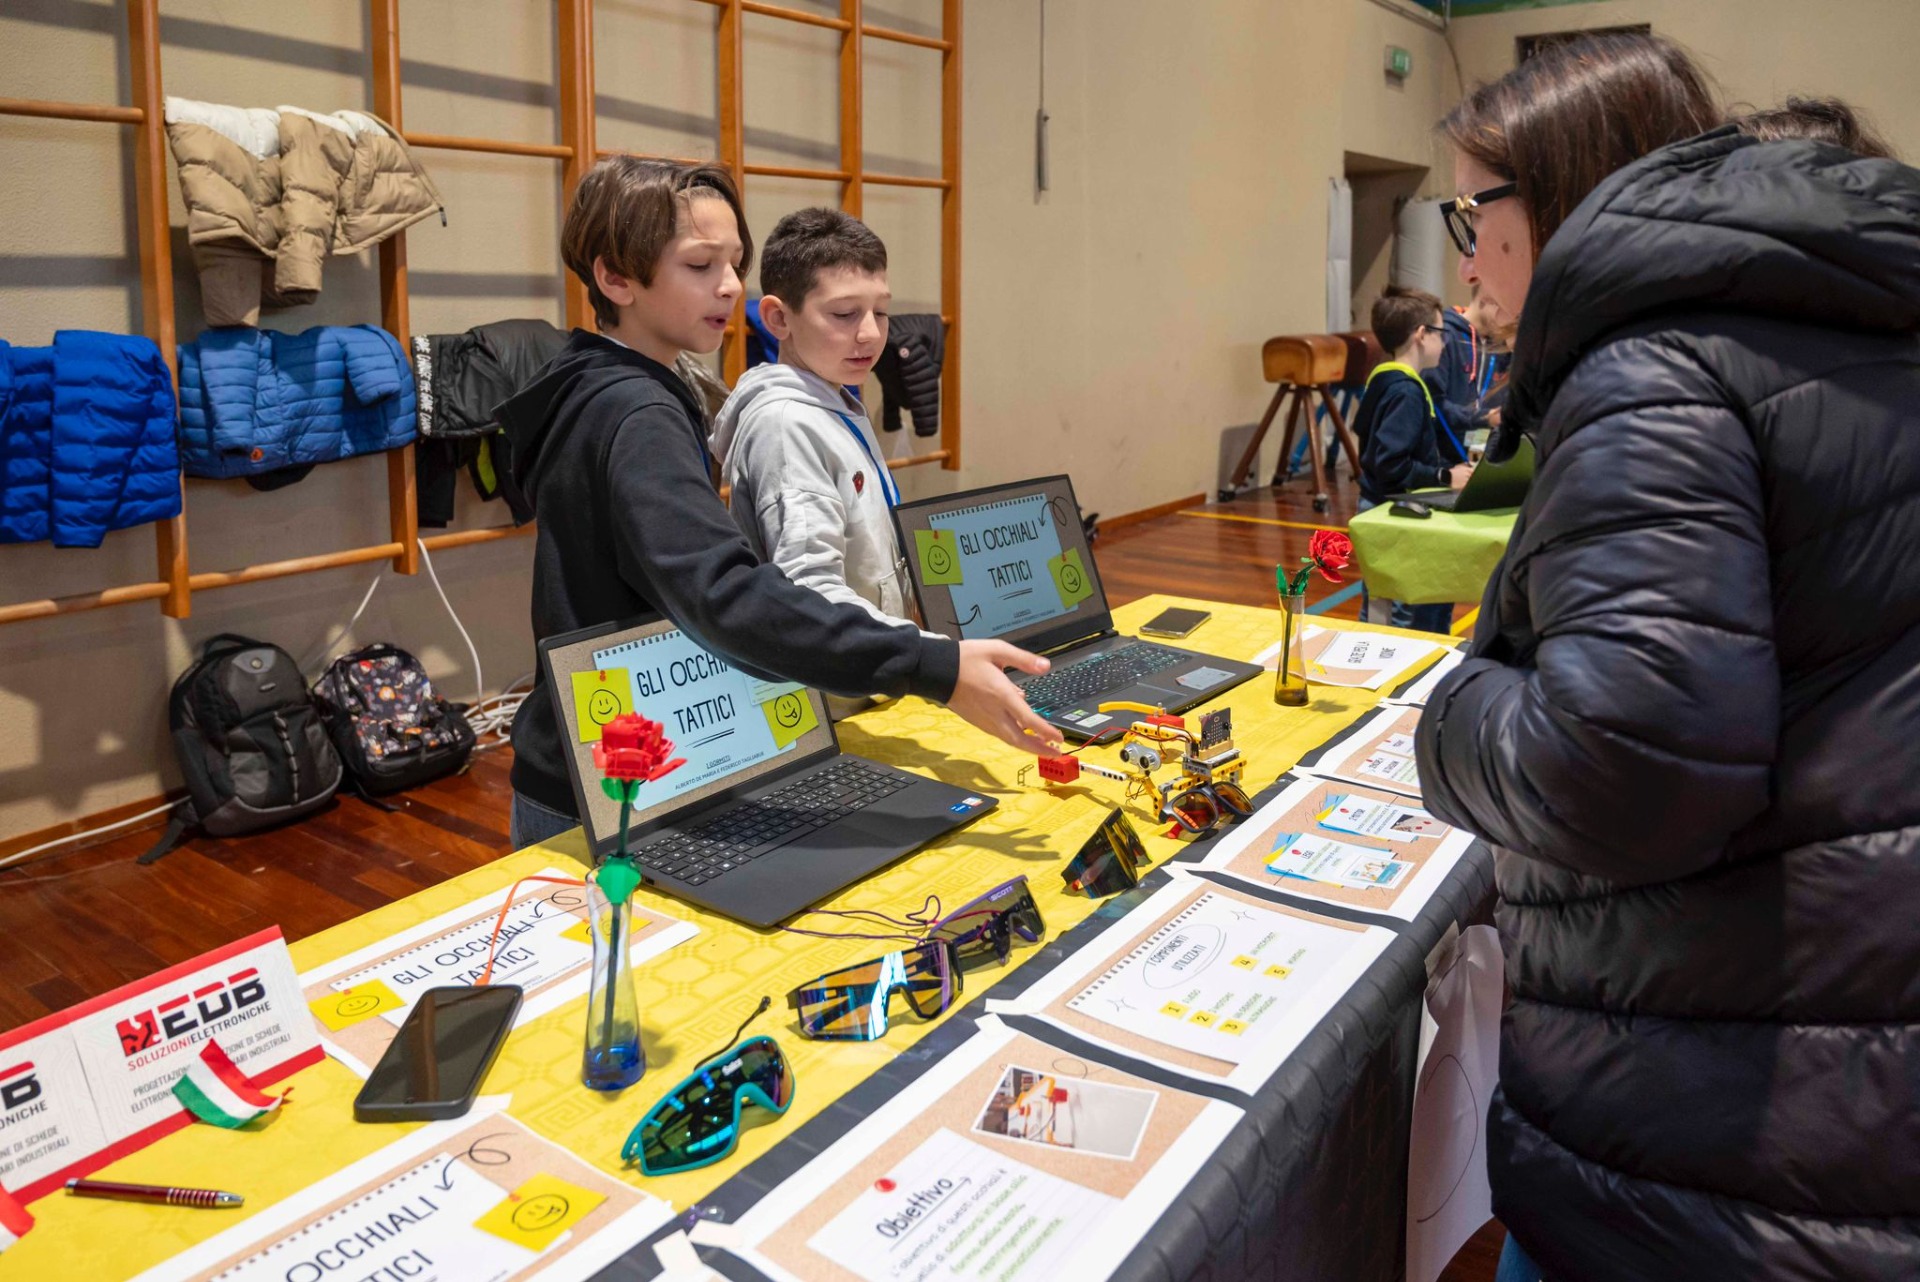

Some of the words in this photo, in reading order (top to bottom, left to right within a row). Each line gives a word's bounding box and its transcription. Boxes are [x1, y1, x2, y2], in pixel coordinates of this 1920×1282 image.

[960, 533, 981, 555] GLI
[983, 520, 1038, 550] OCCHIALI
[988, 560, 1032, 588] TATTICI
[636, 667, 665, 697] GLI
[670, 652, 728, 687] OCCHI
[673, 693, 735, 734] TATTICI
[675, 778, 695, 790] ALBERTO
[702, 769, 717, 779] MARIA
[720, 760, 741, 772] FEDERICO
[990, 885, 1013, 901] SCOTT
[393, 964, 433, 985] GLI
[435, 919, 535, 966] OCCHIALI
[1150, 934, 1189, 964] COMPONENTI
[1171, 944, 1207, 971] UTILIZZATI
[1274, 967, 1285, 975] 5
[1168, 1006, 1181, 1014] 1
[1197, 1014, 1209, 1022] 2
[255, 1024, 281, 1042] SCHEDE
[131, 1088, 172, 1113] ELETTRONI
[249, 1032, 291, 1058] INDUSTRIALI
[25, 1125, 58, 1148] SCHEDE
[16, 1136, 70, 1168] INDUSTRIALI
[876, 1178, 953, 1239] Obiettivo
[946, 1200, 973, 1226] questi
[285, 1196, 438, 1282] OCCHIALI
